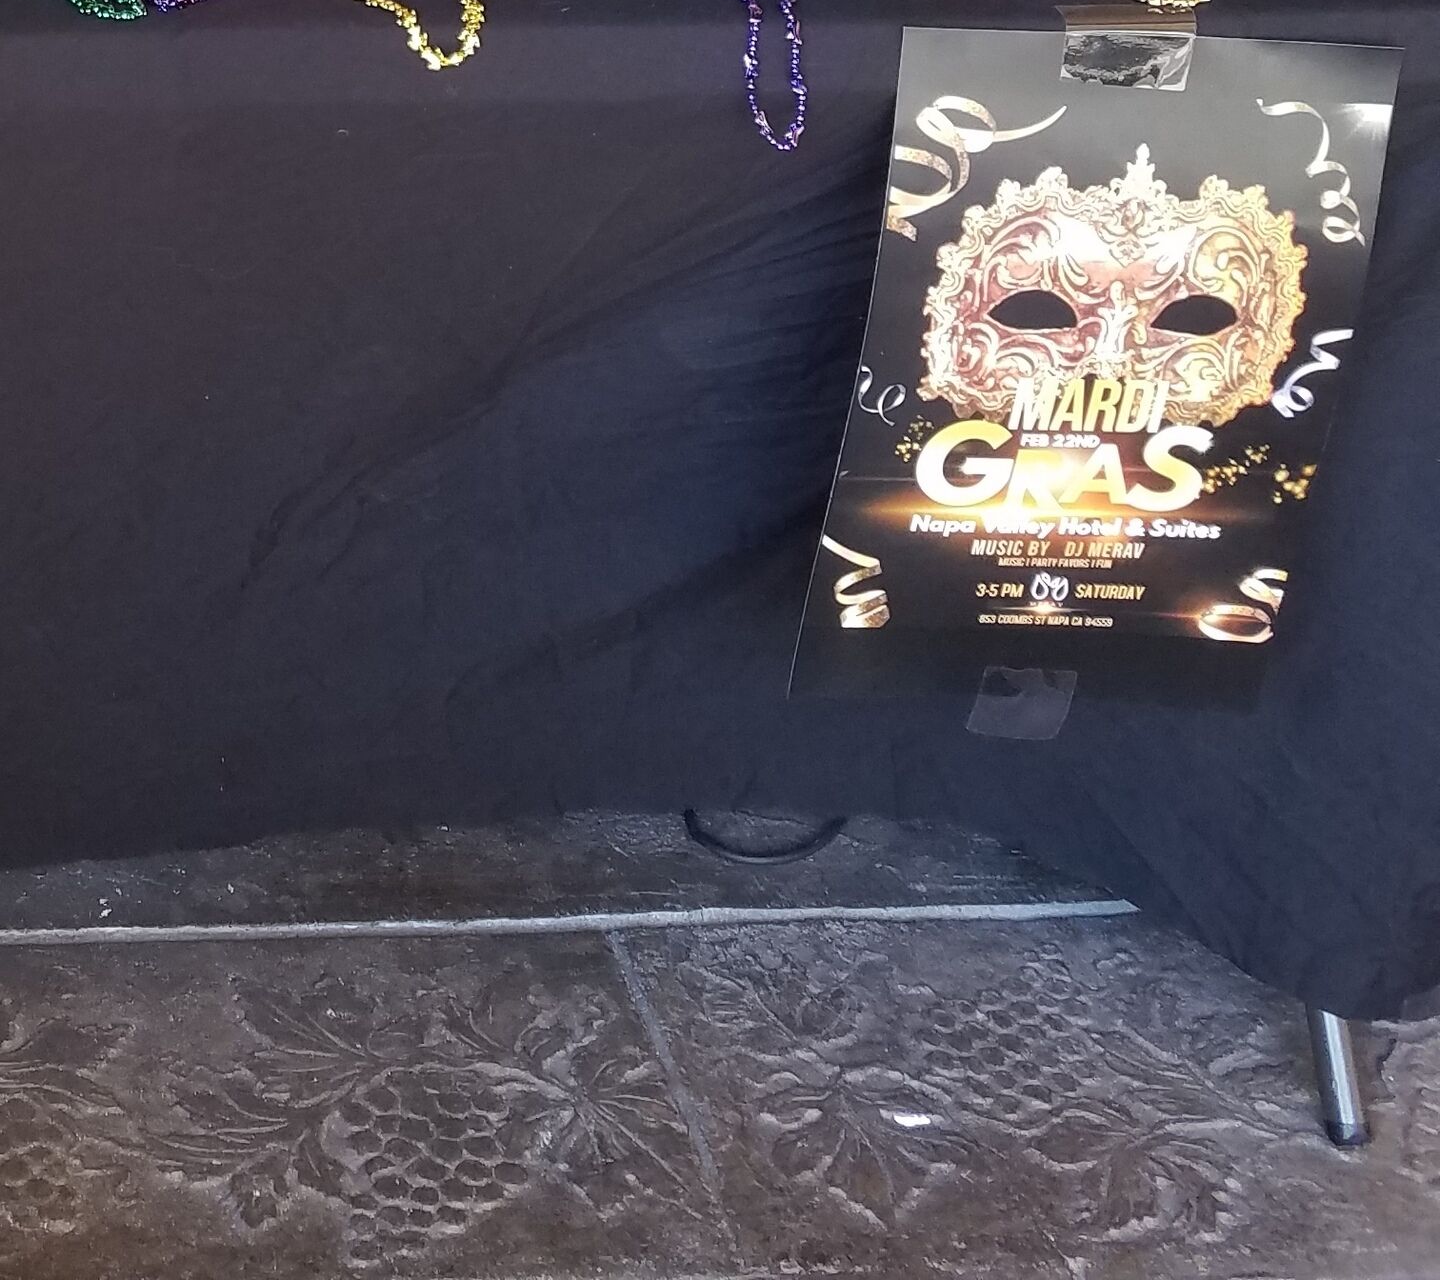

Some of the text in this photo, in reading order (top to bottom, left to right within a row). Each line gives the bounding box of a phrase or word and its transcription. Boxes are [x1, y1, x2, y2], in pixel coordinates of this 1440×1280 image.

[1008, 377, 1171, 434] MARDI
[1049, 434, 1101, 449] 22ND
[916, 419, 1214, 513] GRAS
[909, 513, 977, 538] Napa
[1059, 516, 1123, 537] Hotel
[1124, 517, 1148, 538] &
[1148, 518, 1222, 540] Suites
[971, 539, 1146, 559] MUSIC BY DJ MERAV
[998, 557, 1026, 567] MUSIC
[1031, 558, 1059, 568] PARTY
[1059, 559, 1090, 568] FAVORS
[1095, 559, 1113, 569] FUN
[975, 583, 1146, 601] 3-5 PM SATURDAY
[1034, 615, 1046, 626] ST
[1046, 616, 1070, 627] NAPA
[1071, 616, 1083, 627] CA
